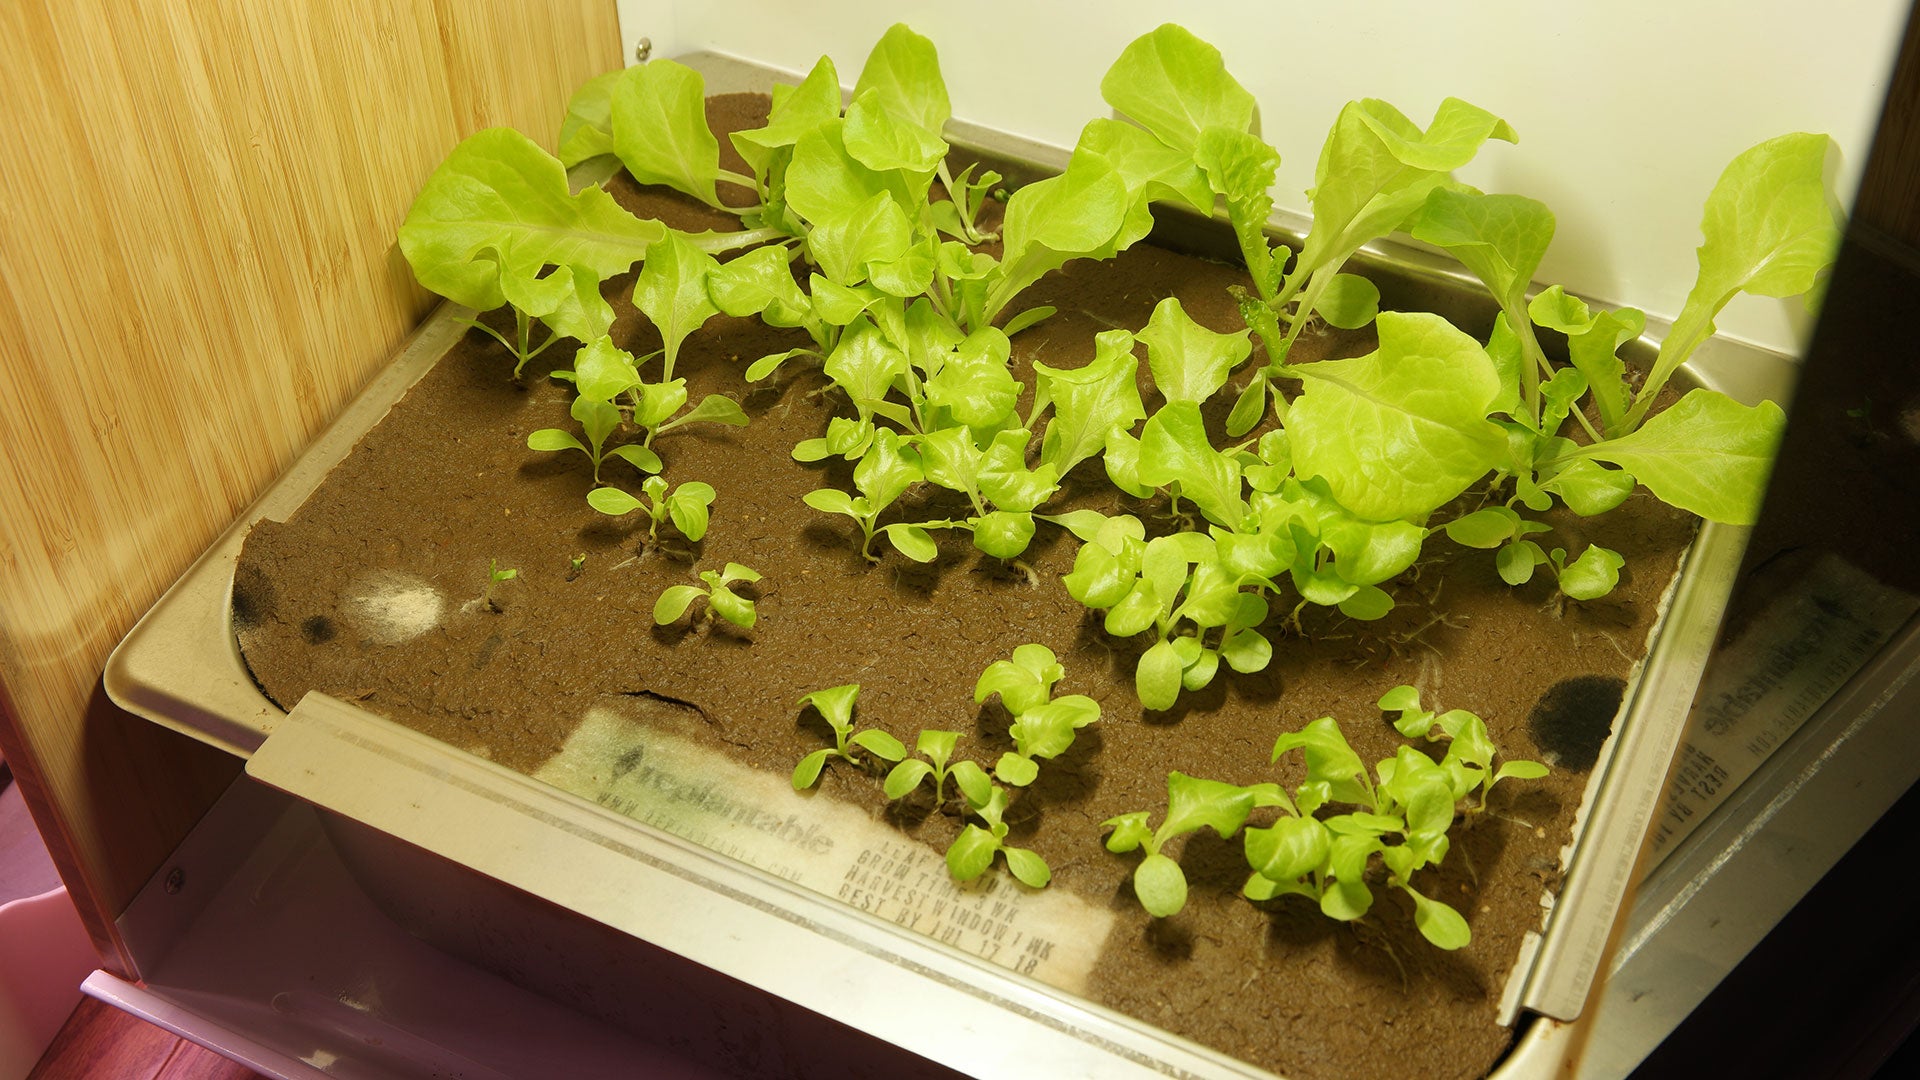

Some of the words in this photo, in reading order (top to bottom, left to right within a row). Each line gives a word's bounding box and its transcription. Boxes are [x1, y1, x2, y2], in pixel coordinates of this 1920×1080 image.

[844, 864, 930, 910] HARVEST
[932, 899, 1009, 942] WINDOW
[856, 849, 911, 882] GROW
[991, 901, 1020, 924] WK
